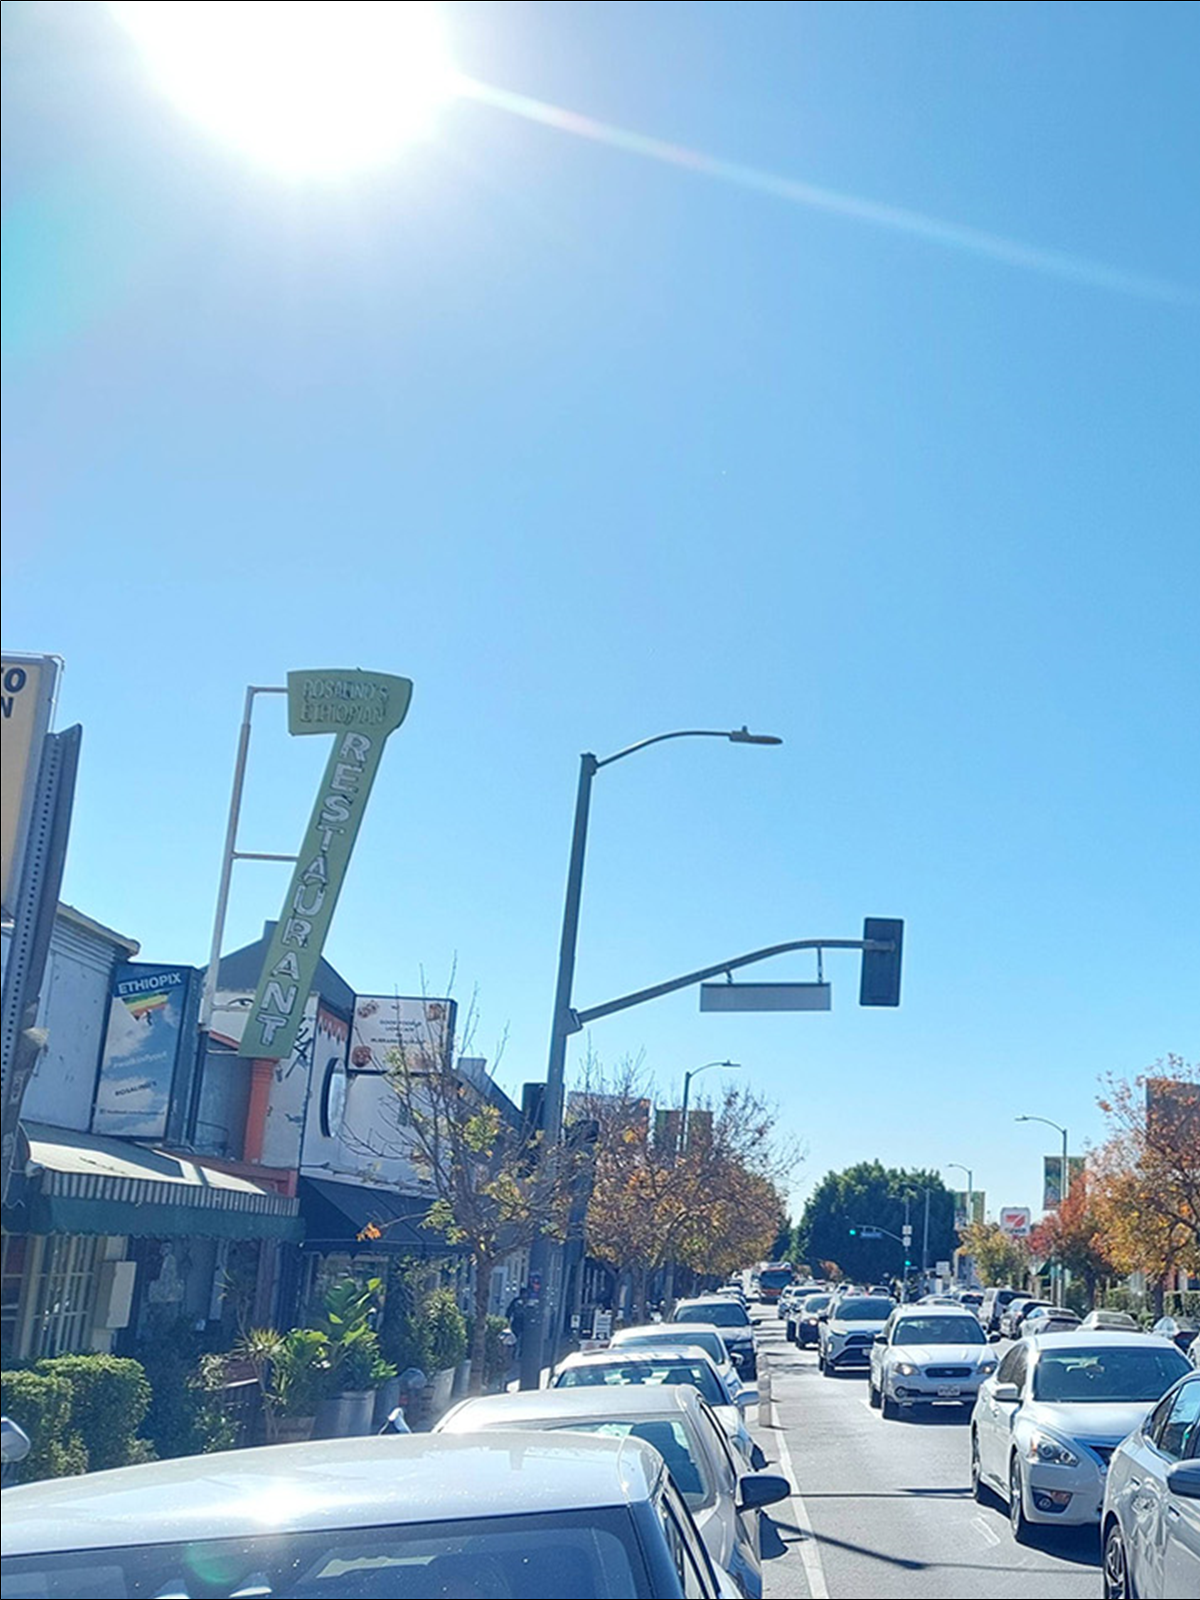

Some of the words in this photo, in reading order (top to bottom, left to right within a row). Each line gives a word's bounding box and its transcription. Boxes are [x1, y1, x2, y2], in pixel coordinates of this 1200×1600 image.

[1, 667, 27, 693] O
[256, 731, 372, 1046] RESTAURANT
[117, 972, 182, 994] ETHIOPIX
